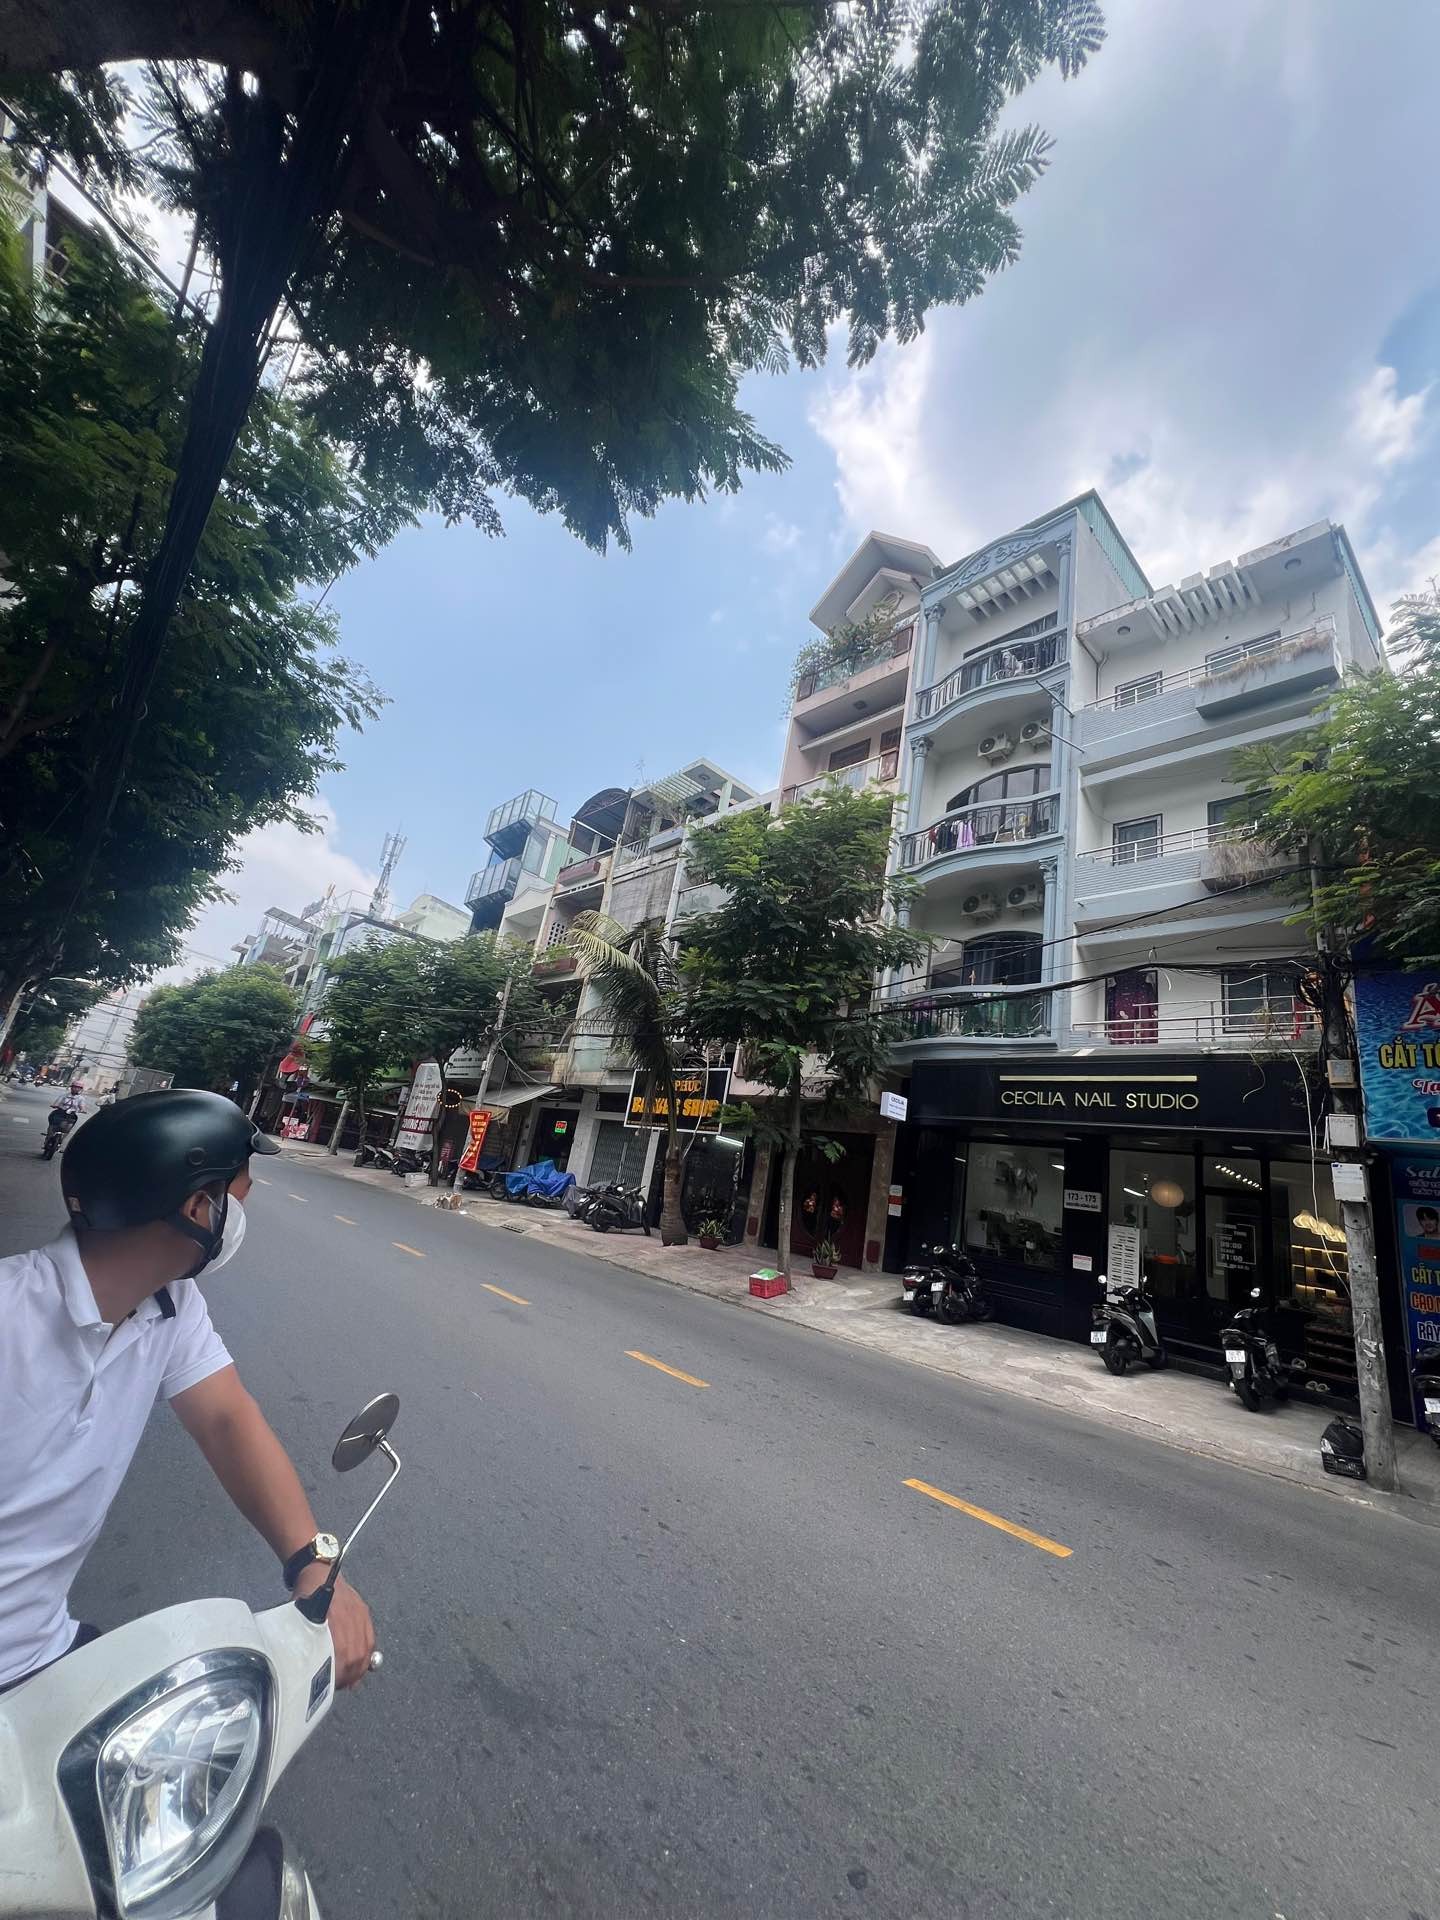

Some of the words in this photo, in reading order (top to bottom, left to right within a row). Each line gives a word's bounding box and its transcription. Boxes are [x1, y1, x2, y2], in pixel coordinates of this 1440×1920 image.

[1380, 1036, 1416, 1068] CẮT
[1000, 1091, 1066, 1106] CECILIA
[1075, 1092, 1117, 1107] NAIL
[1126, 1093, 1199, 1110] STUDIO
[1068, 1192, 1079, 1201] 173
